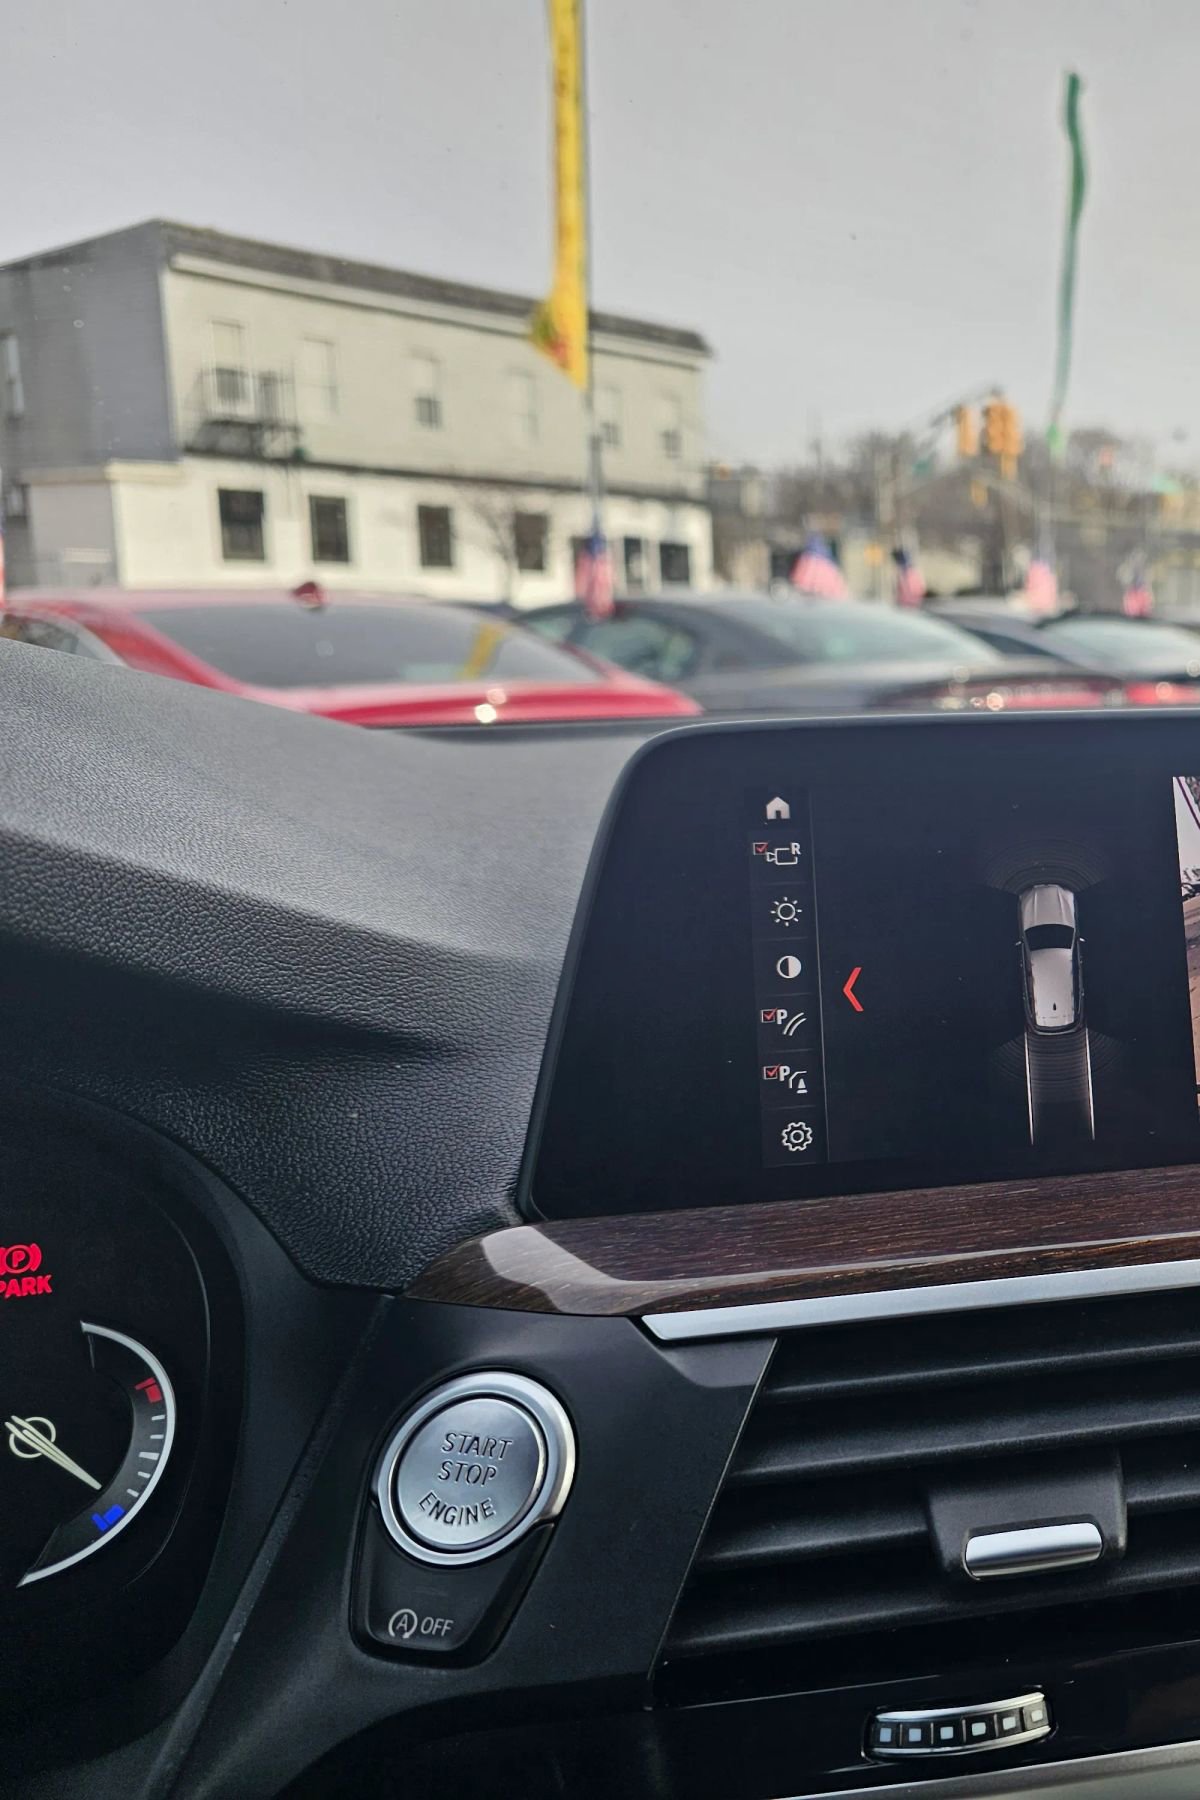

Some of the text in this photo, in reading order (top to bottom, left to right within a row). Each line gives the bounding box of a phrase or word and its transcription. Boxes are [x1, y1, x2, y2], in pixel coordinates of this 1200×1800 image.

[442, 1431, 512, 1461] START
[437, 1460, 497, 1487] STOP
[417, 1490, 496, 1527] ENGINE
[420, 1615, 454, 1637] OFF
